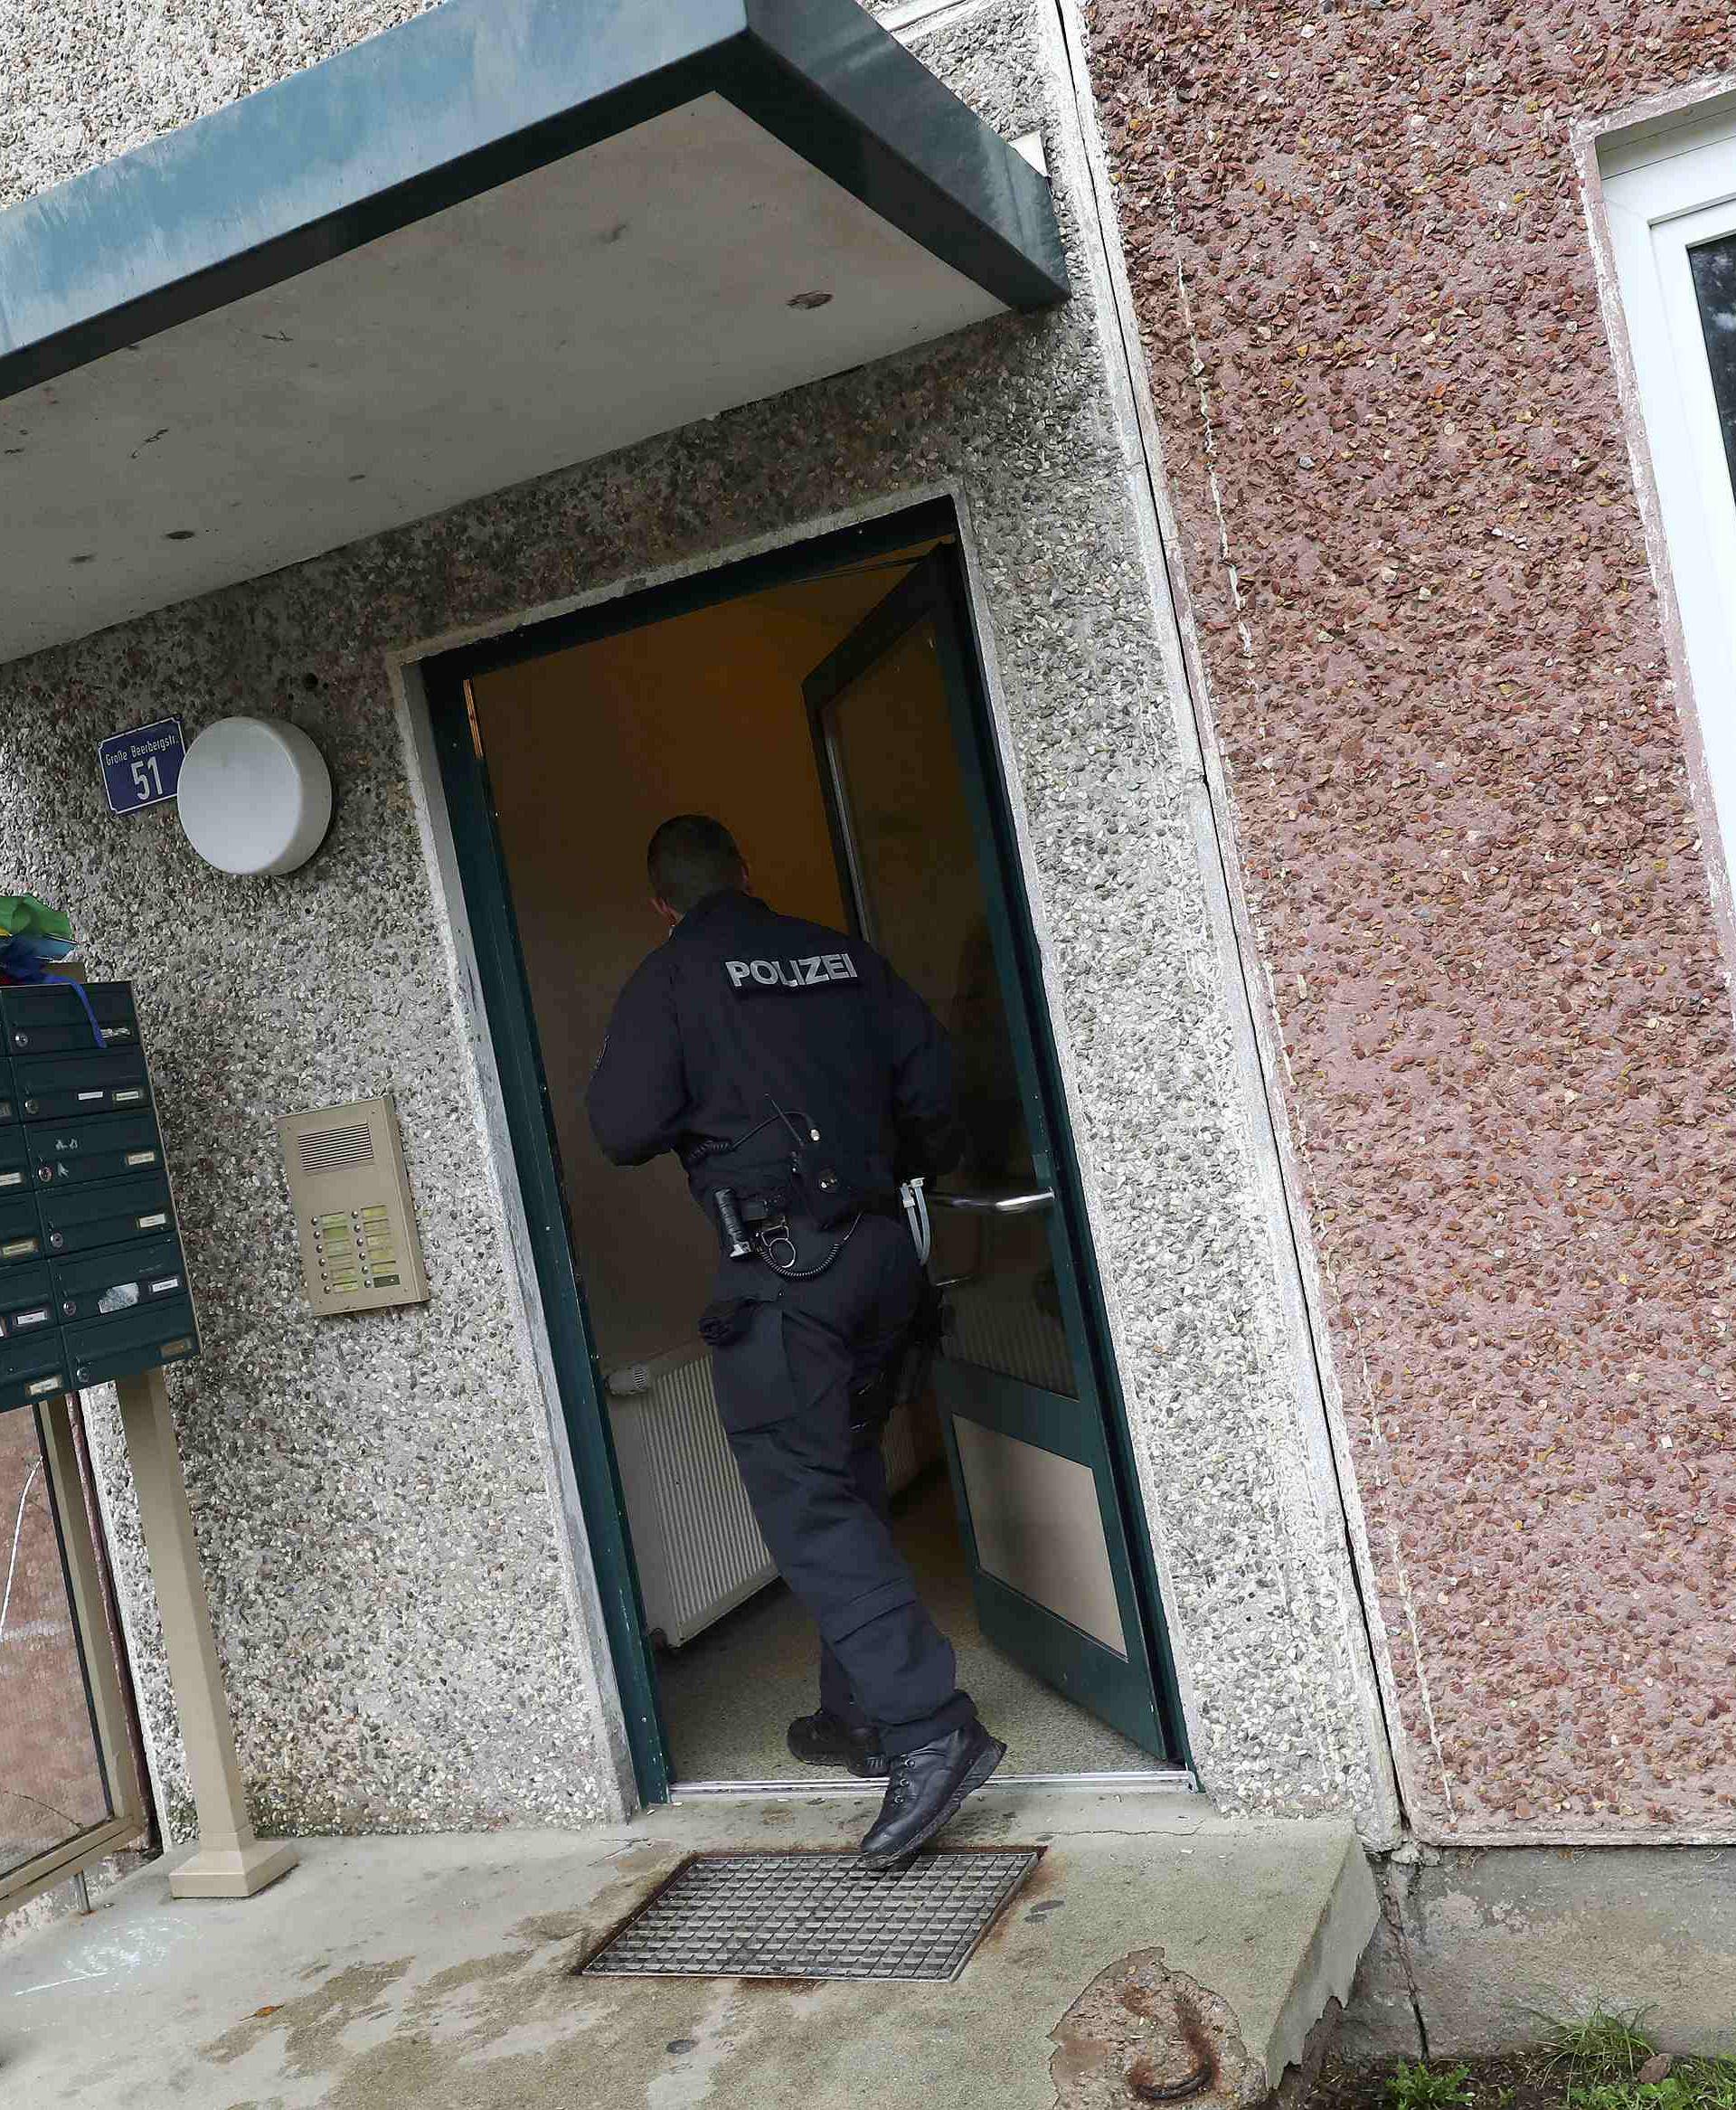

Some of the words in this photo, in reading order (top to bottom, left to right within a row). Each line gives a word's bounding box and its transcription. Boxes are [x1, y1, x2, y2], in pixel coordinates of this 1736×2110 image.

[105, 750, 127, 766] Große
[131, 756, 163, 800] 51
[725, 953, 858, 987] POLIZEI
